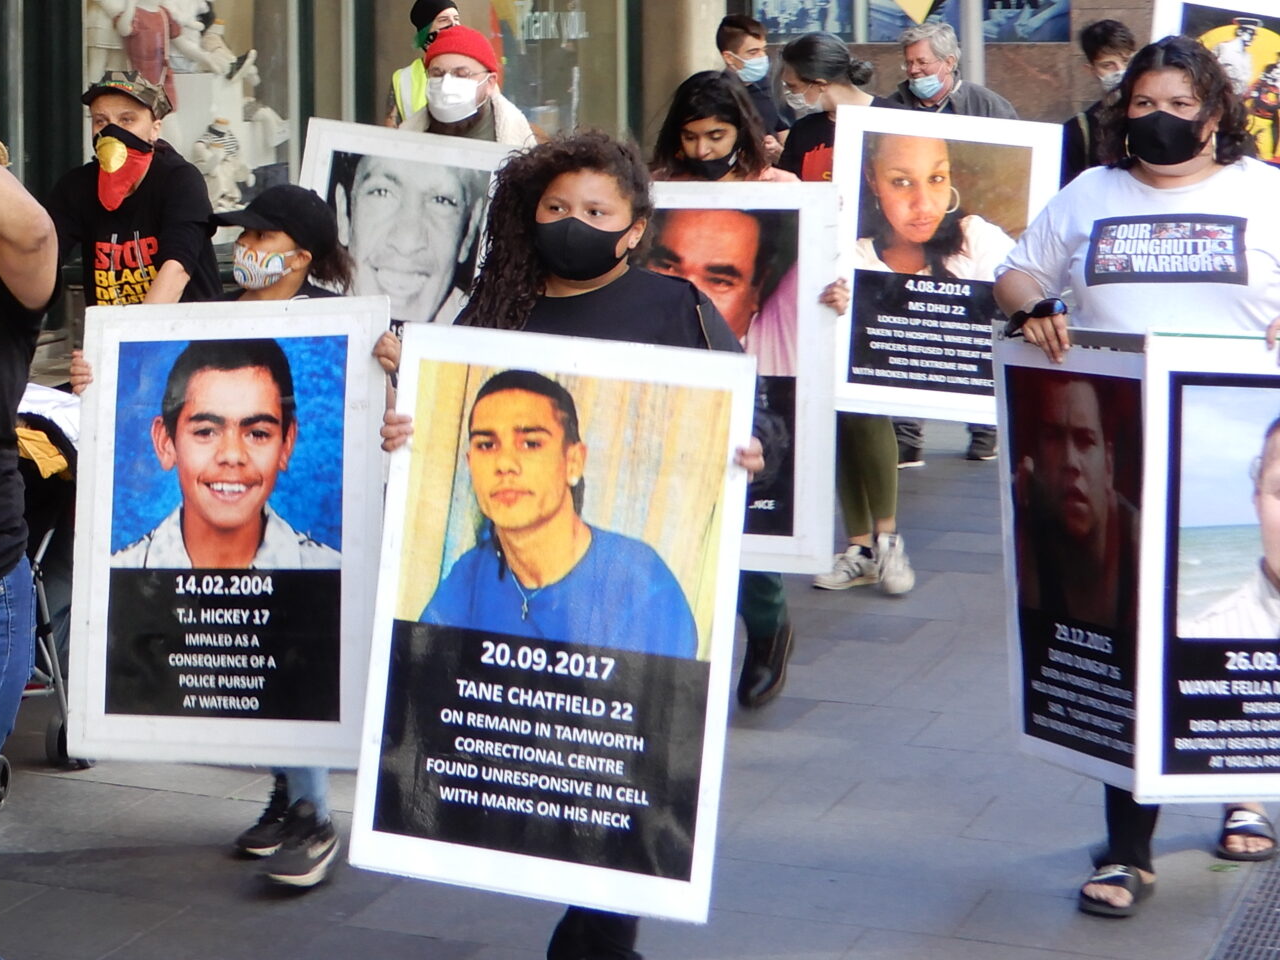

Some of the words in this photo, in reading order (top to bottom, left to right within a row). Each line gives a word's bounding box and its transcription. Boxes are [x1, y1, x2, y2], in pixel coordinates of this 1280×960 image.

[1117, 223, 1152, 239] OUR
[95, 236, 158, 270] STOP
[1131, 254, 1213, 272] WARRIOR
[904, 279, 971, 297] 4.08.2014
[908, 301, 926, 312] MS
[927, 302, 951, 314] DHU
[951, 305, 966, 316] 22
[877, 314, 909, 325] LOCKED
[909, 318, 921, 327] UP
[922, 319, 939, 328] FOR
[865, 326, 892, 337] TAKEN
[893, 329, 905, 339] TO
[905, 330, 943, 342] HOSPITAL
[943, 334, 973, 345] WHERE
[869, 340, 907, 352] OFFICERS
[944, 347, 956, 357] TO
[175, 575, 274, 595] 14.02.2004
[176, 608, 197, 624] T.J.
[200, 608, 250, 624] HICKEY
[252, 609, 270, 625] 17
[185, 633, 233, 647] IMPALED
[234, 634, 249, 647] AS
[250, 634, 260, 648] A
[168, 653, 248, 669] CONSEQUENCE
[250, 655, 265, 669] OF
[267, 655, 277, 669] A
[480, 640, 616, 681] 20.09.2017
[1224, 651, 1280, 671] 26.09.
[179, 674, 216, 688] POLICE
[218, 675, 265, 689] PURSUIT
[1178, 679, 1231, 695] WAYNE
[1231, 680, 1273, 695] FELLA
[183, 695, 197, 708] AT
[198, 695, 260, 710] WATERLOO
[456, 678, 503, 704] TANE
[507, 685, 606, 717] CHATFIELD
[610, 700, 634, 722] 22
[440, 708, 464, 725] ON
[466, 711, 532, 735] REMAND
[534, 722, 551, 739] IN
[554, 724, 645, 752] TAMWORTH
[454, 735, 565, 767] CORRECTIONAL
[567, 753, 625, 776] CENTRE
[426, 757, 479, 779] FOUND
[481, 765, 593, 797] UNRESPONSIVE
[596, 783, 613, 800] IN
[615, 786, 650, 806] CELL
[439, 785, 479, 805] WITH
[481, 791, 535, 814] MARKS
[537, 800, 561, 819] ON
[563, 804, 588, 823] HIS
[591, 809, 632, 830] NECK
